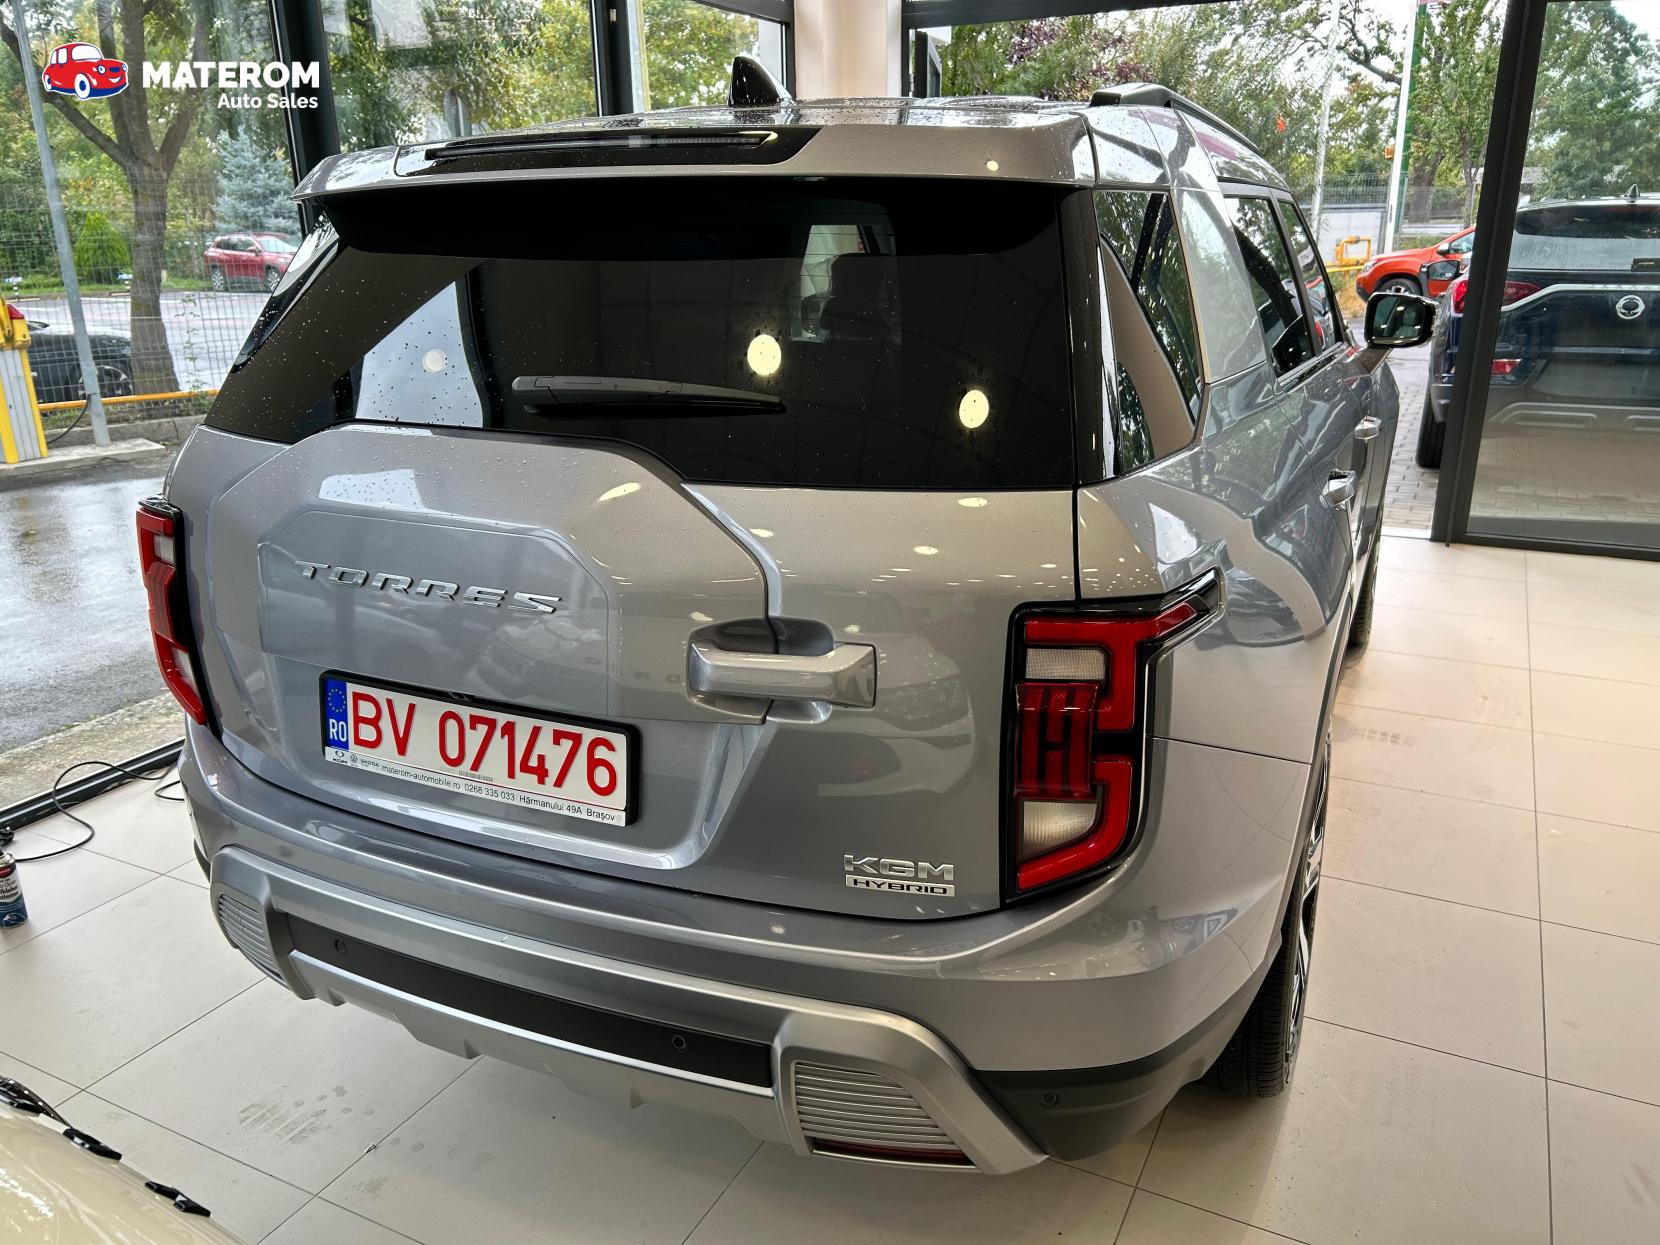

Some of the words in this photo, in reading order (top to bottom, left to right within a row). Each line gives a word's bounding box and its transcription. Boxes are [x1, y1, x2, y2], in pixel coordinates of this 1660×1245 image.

[294, 560, 562, 615] TORRES
[329, 718, 347, 743] RO
[352, 691, 416, 757] BV
[438, 710, 617, 797] 071476
[464, 783, 483, 795] 0268
[485, 787, 499, 798] 335
[500, 790, 515, 802] 033
[566, 804, 582, 815] 49A
[844, 854, 954, 881] KGM
[852, 878, 949, 895] HYBRID
